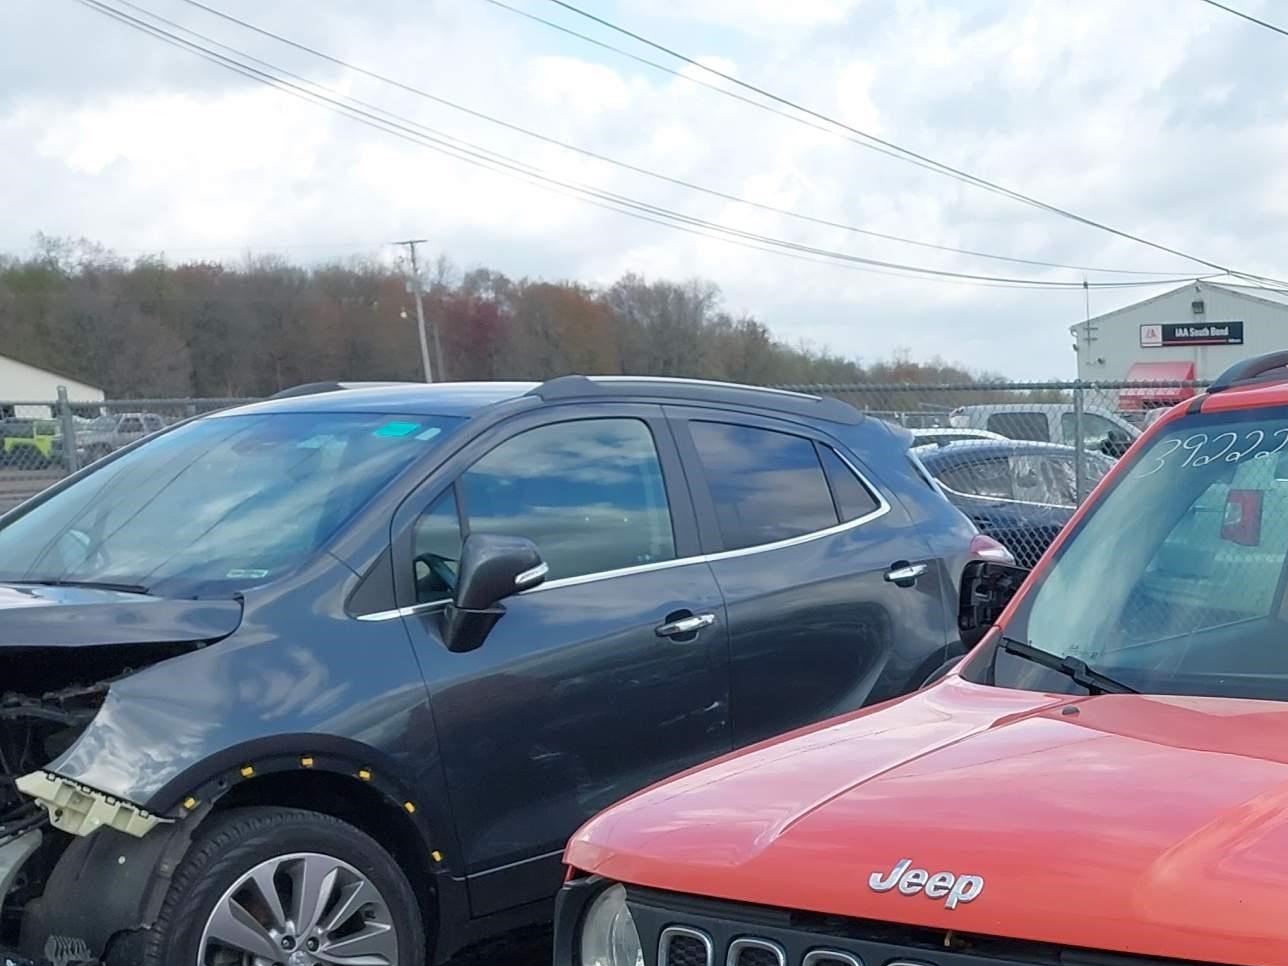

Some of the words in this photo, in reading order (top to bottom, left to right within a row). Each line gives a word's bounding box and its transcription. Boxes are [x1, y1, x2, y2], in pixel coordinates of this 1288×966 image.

[1175, 327, 1189, 338] IAA
[1211, 326, 1229, 336] Bend
[868, 858, 985, 910] Jeep
